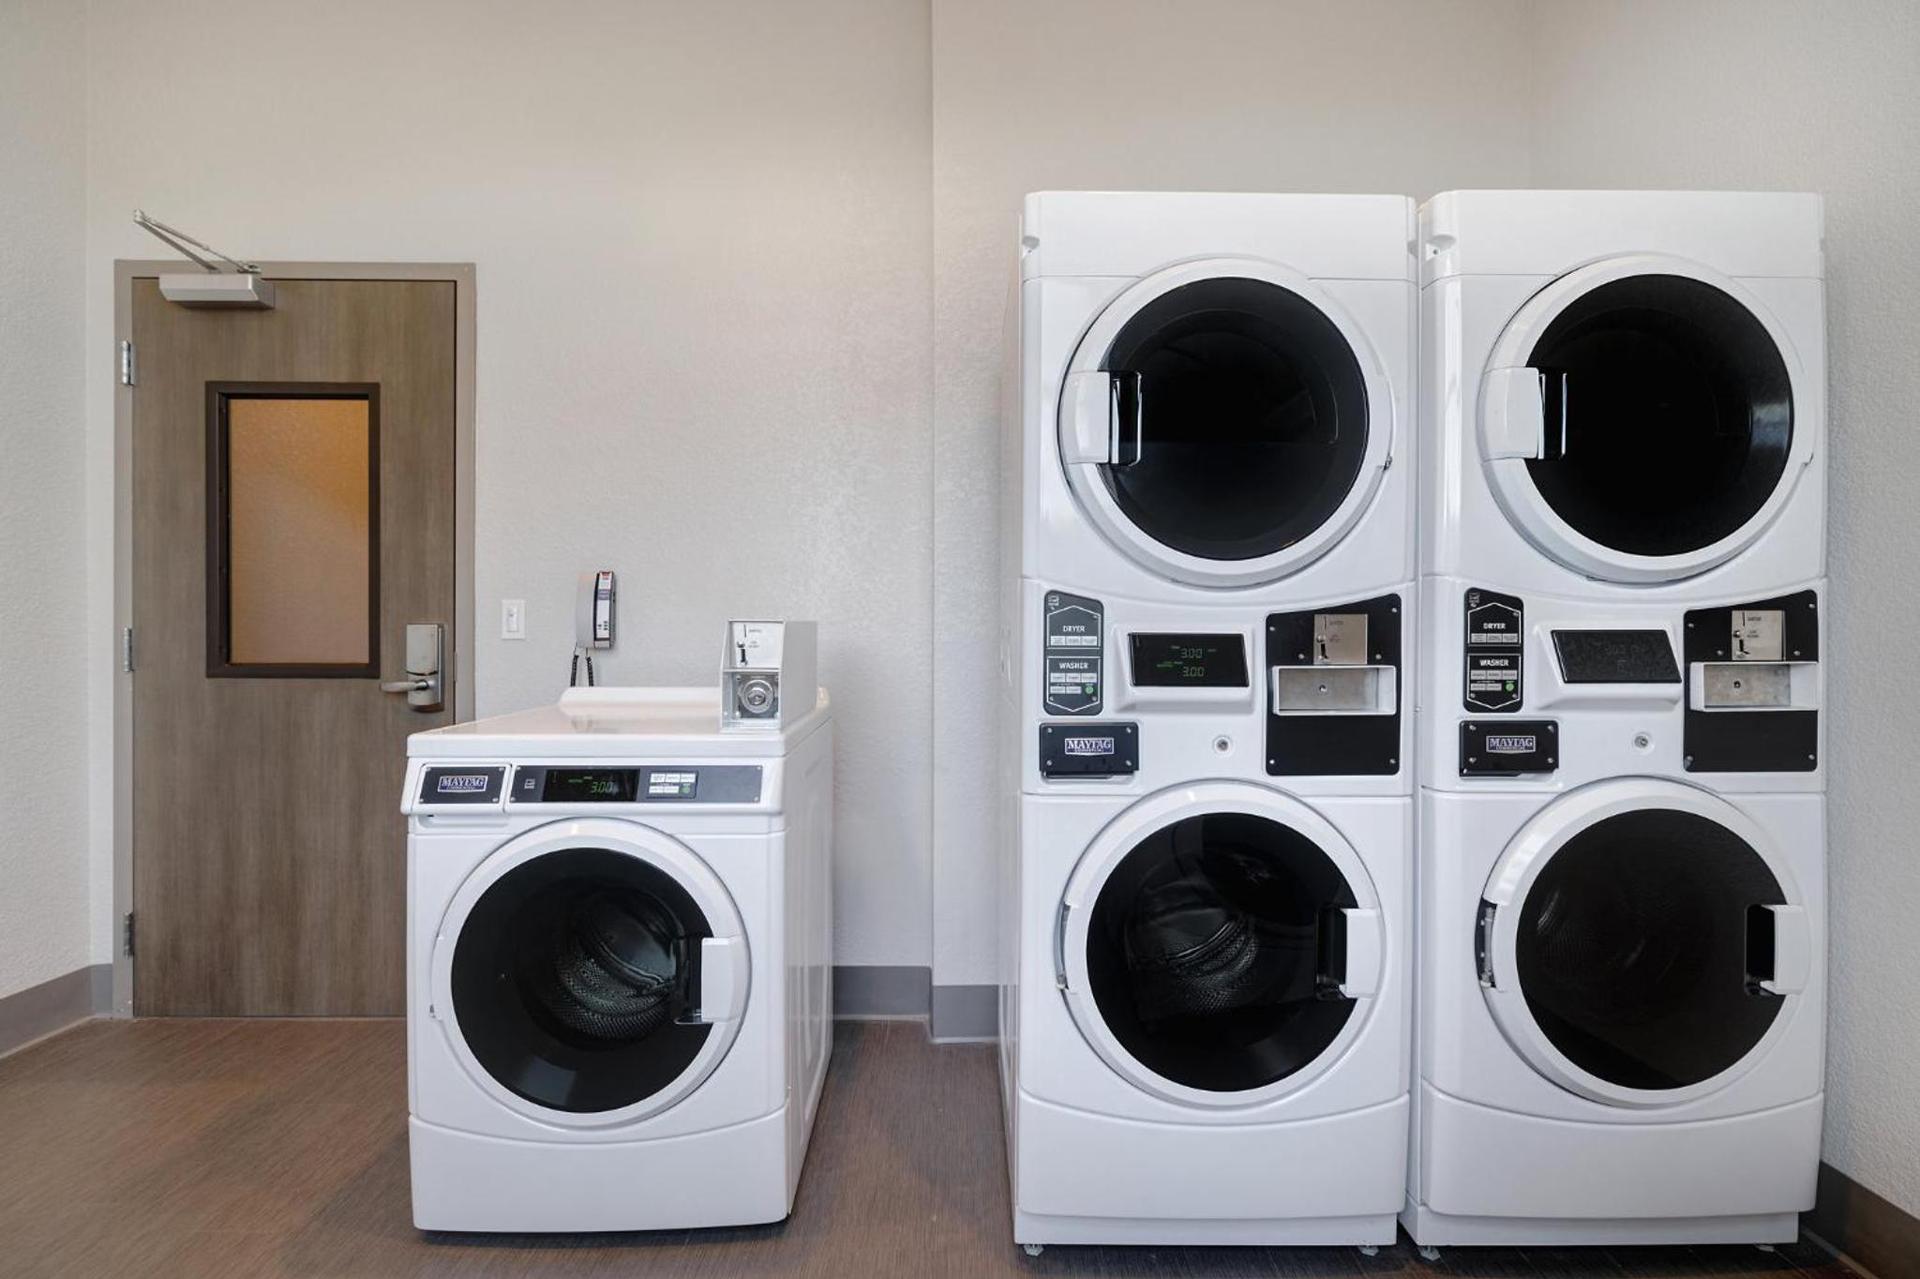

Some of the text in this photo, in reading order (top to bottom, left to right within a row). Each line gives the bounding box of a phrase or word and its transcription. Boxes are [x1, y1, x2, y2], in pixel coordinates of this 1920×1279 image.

[1483, 622, 1506, 630] DRYER
[1059, 662, 1089, 670] WASHER
[1480, 659, 1509, 667] WASHER
[1067, 740, 1112, 750] MAYTAG
[1489, 738, 1533, 748] MAYTAG
[441, 777, 485, 787] MAYTAG
